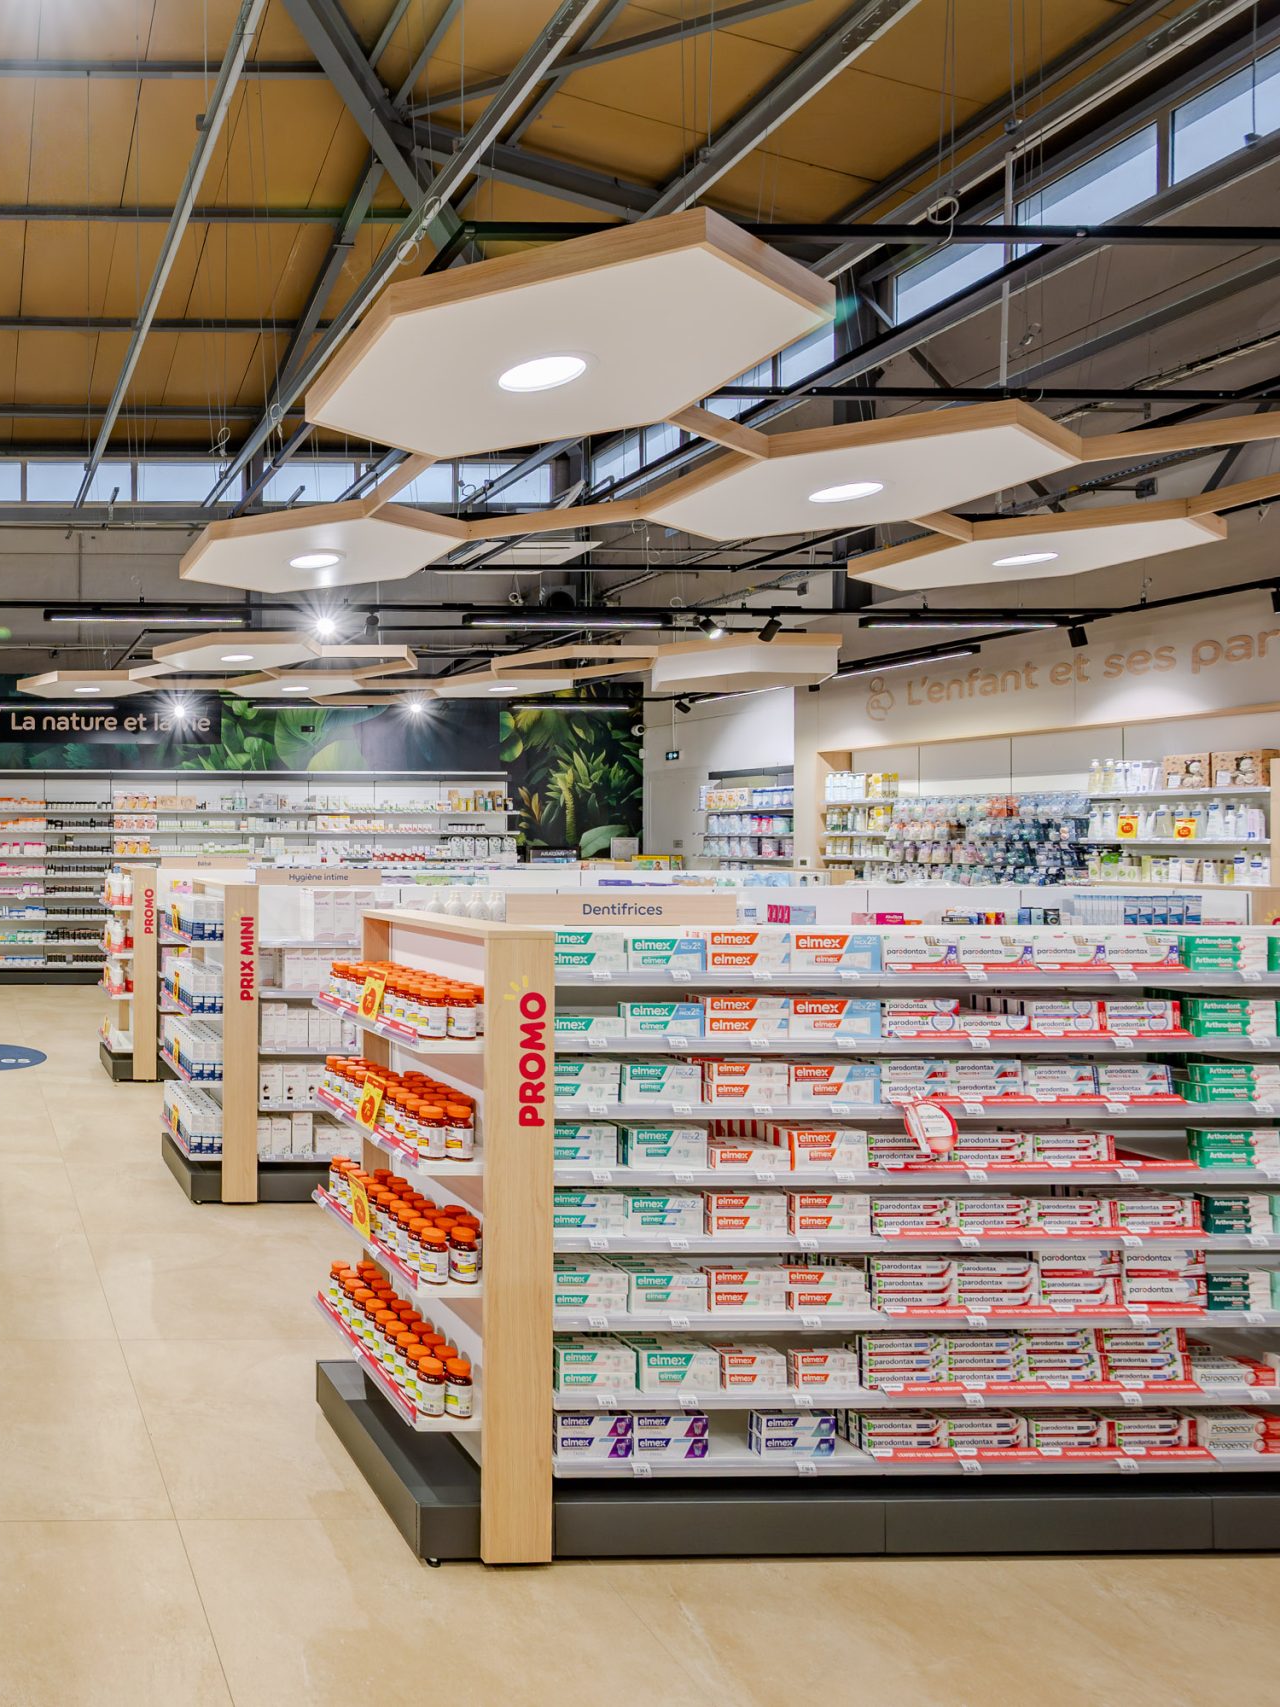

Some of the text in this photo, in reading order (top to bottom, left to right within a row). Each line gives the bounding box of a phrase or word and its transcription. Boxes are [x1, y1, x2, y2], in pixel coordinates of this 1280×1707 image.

[908, 661, 1039, 706] L'enfant
[1049, 654, 1091, 687] et
[1104, 646, 1177, 679] ses
[10, 712, 36, 731] La
[42, 711, 119, 731] nature
[123, 713, 147, 731] et
[153, 711, 173, 731] la
[289, 872, 349, 885] Hygiène intime
[144, 888, 154, 934] PROMO
[582, 903, 663, 917] Dentifrices
[556, 933, 585, 944] lmex
[713, 934, 750, 944] elmex
[799, 936, 841, 948] elmex
[635, 940, 670, 950] elmex
[887, 948, 927, 956] parodontax
[962, 948, 1002, 956] parodontax
[240, 916, 254, 1001] PRIX MINI
[643, 956, 667, 964] elmex
[714, 954, 750, 964] elmex
[713, 999, 749, 1009] elmex
[796, 1002, 839, 1013] elmex
[889, 1002, 927, 1010] parodontax
[632, 1006, 670, 1015] elmex
[641, 1022, 665, 1030] elmex
[712, 1019, 749, 1030] elmex
[889, 1019, 929, 1027] parodontax
[963, 1019, 1001, 1027] parodontax
[519, 992, 546, 1127] PROMO
[632, 1067, 662, 1075] elmex
[796, 1068, 828, 1077] elmex
[718, 1085, 745, 1093] elmex
[958, 1084, 996, 1092] parodontax
[639, 1132, 667, 1140] elmex
[799, 1133, 831, 1142] elmex
[959, 1136, 999, 1145] parodontax
[721, 1151, 748, 1159] elmex
[810, 1150, 832, 1158] elmex
[873, 1152, 914, 1160] parodontax
[554, 1195, 581, 1203] elmex
[718, 1197, 744, 1205] elmex
[634, 1200, 663, 1208] elmex
[879, 1203, 920, 1211] parodontax
[554, 1216, 580, 1224] elmex
[882, 1263, 922, 1271] parodontax
[558, 1274, 585, 1282] elmex
[638, 1277, 667, 1285] elmex
[799, 1294, 827, 1302] elmex
[964, 1296, 1004, 1304] parodontax
[954, 1341, 993, 1349] parodontax
[566, 1353, 592, 1361] elmex
[649, 1355, 686, 1365] elmex
[874, 1375, 914, 1383] parodontax
[562, 1417, 589, 1425] elmex
[639, 1417, 666, 1425] elmex
[639, 1439, 666, 1447] elmex
[767, 1439, 793, 1447] elmex
[873, 1439, 912, 1447] parodontax
